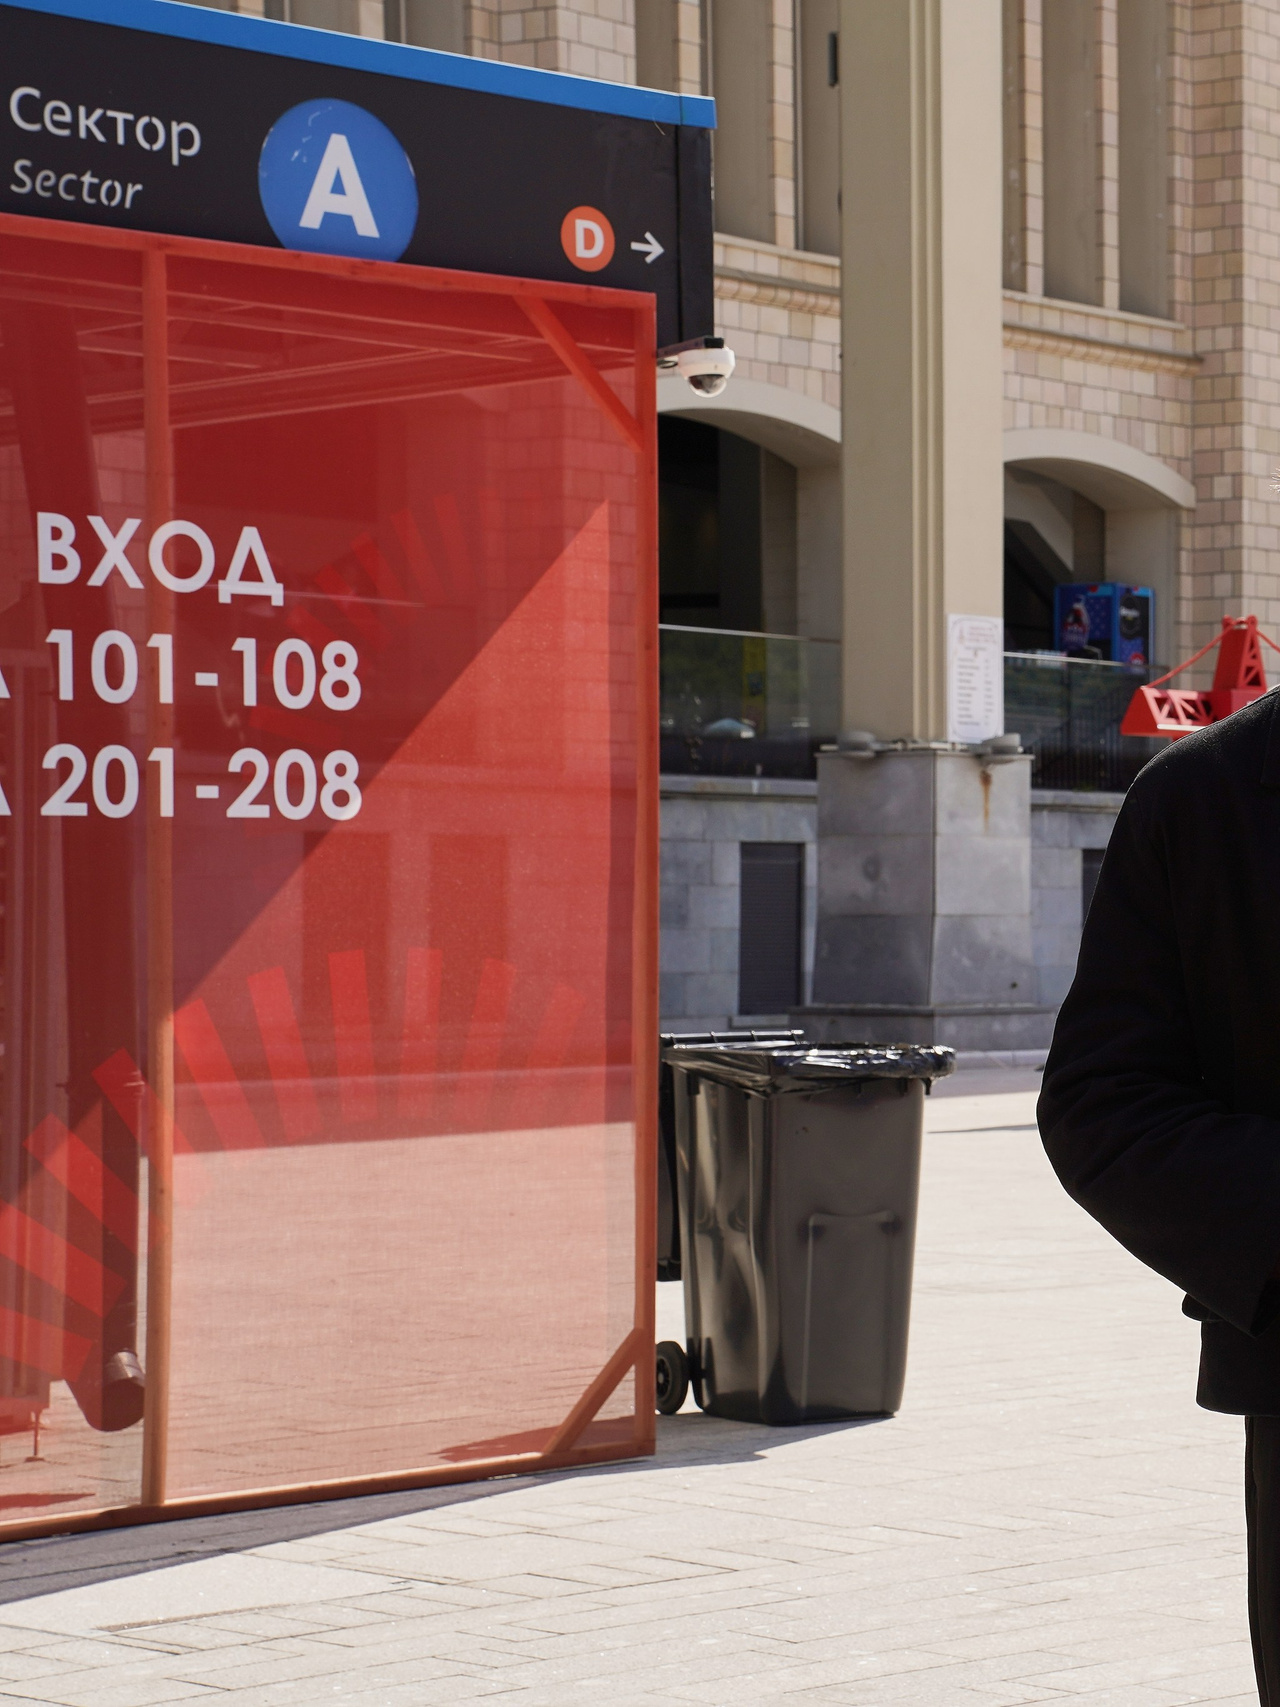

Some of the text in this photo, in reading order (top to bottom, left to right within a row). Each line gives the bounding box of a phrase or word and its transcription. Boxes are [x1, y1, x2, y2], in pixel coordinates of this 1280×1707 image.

[9, 86, 202, 167] Сектор
[10, 158, 143, 209] Sector
[298, 132, 381, 239] A
[573, 220, 606, 260] D
[36, 511, 285, 607] ВХОД
[45, 628, 362, 712] 101-108
[40, 743, 363, 822] 201-208
